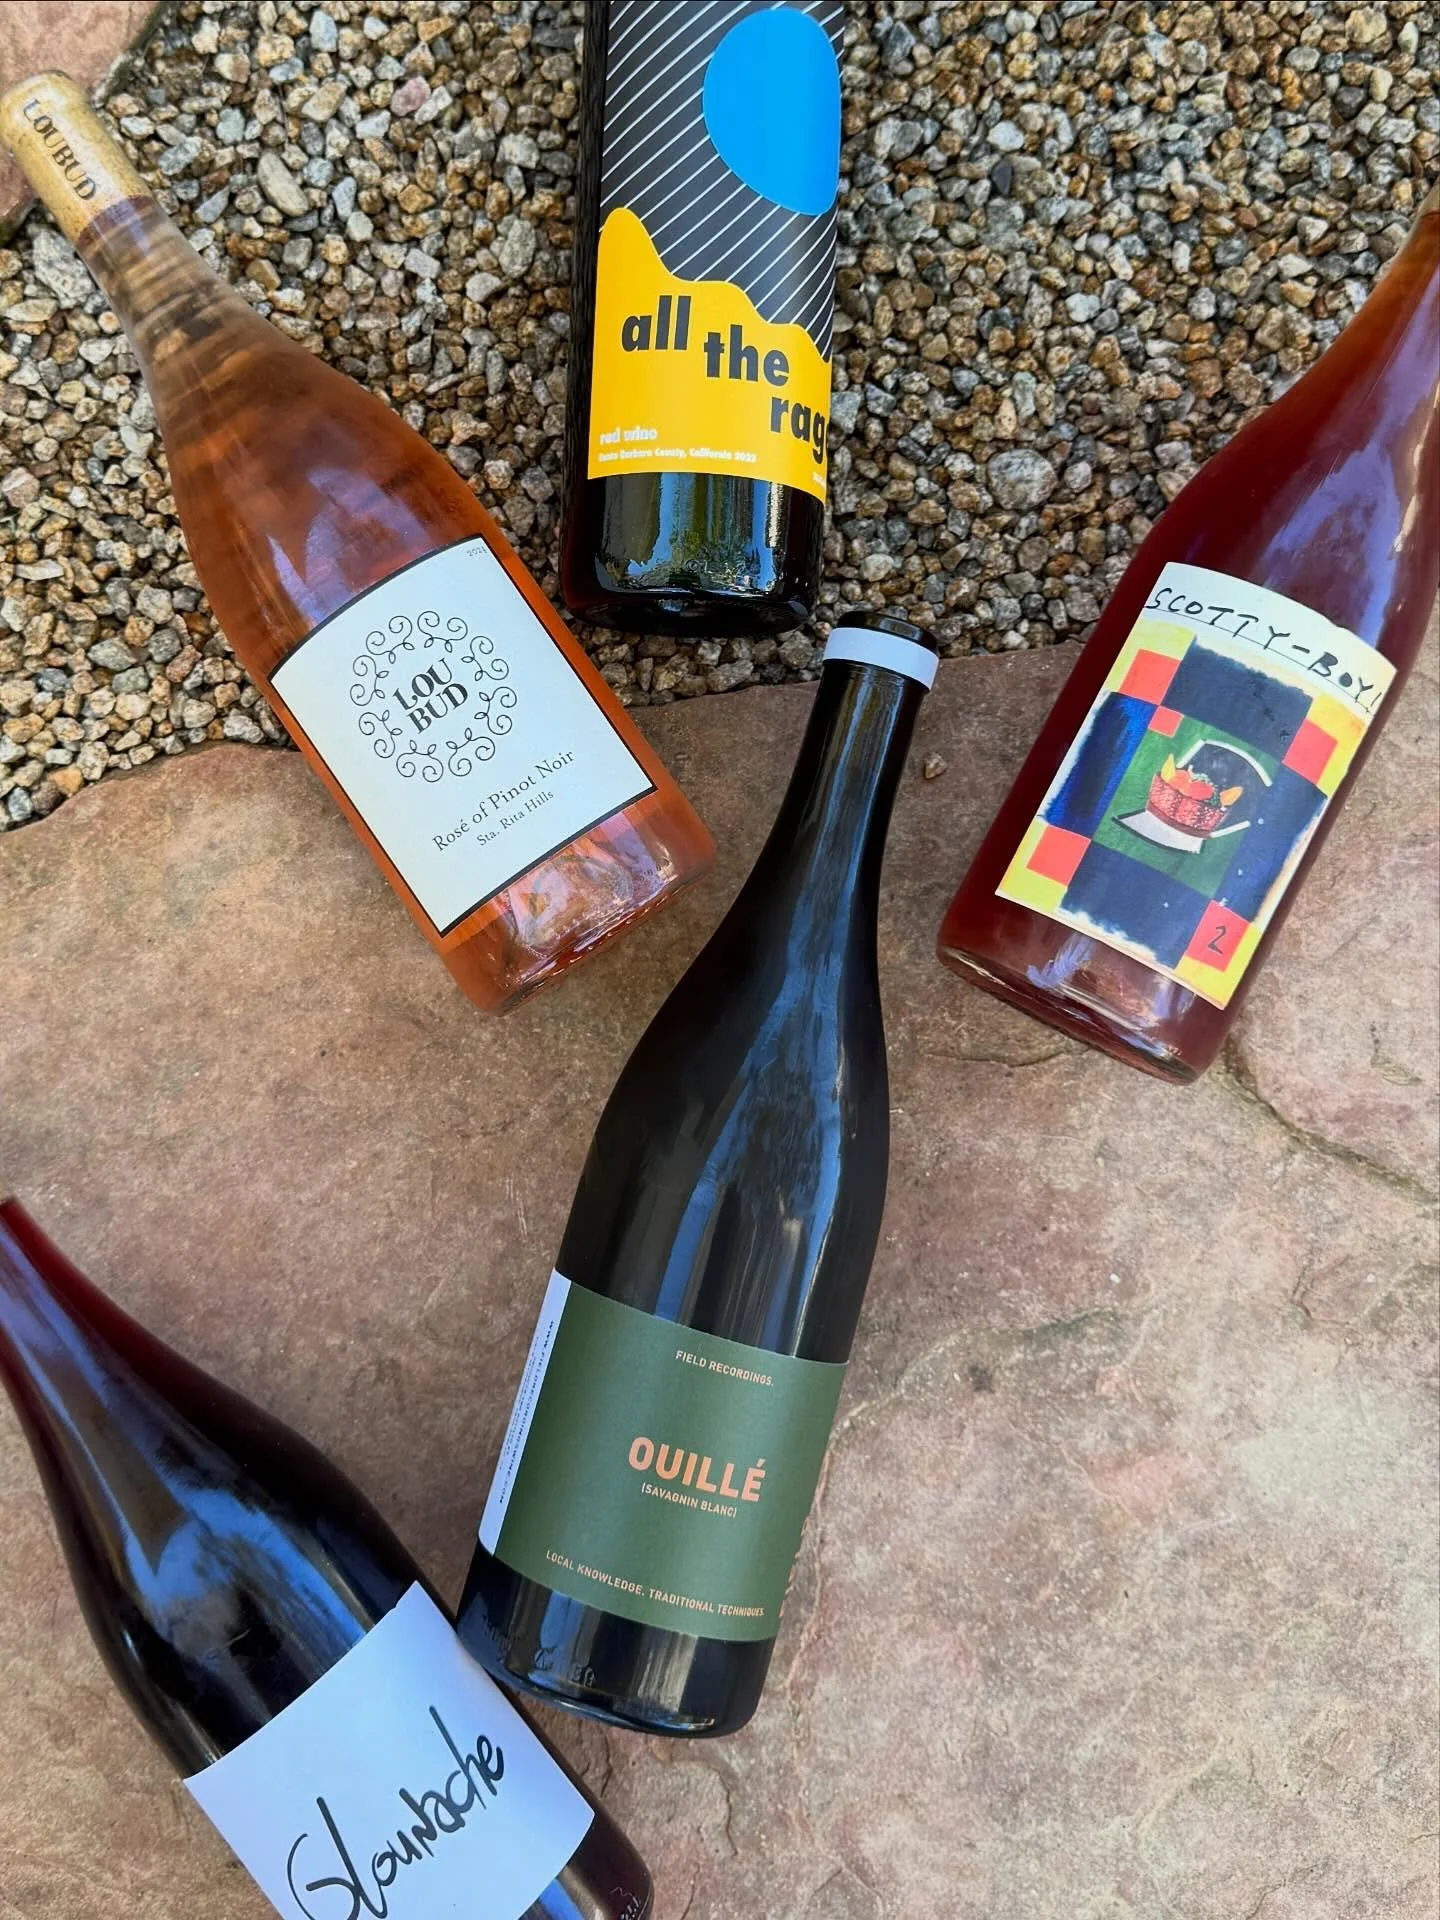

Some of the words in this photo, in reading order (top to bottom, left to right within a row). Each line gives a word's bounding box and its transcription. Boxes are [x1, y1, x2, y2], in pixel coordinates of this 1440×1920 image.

[621, 295, 692, 352] all
[704, 324, 790, 387] the
[689, 447, 733, 460] California
[770, 396, 829, 465] rag
[392, 658, 456, 711] LOU
[407, 682, 469, 735] BUD
[432, 819, 470, 851] Rosé
[472, 801, 489, 824] of
[488, 775, 537, 810] Pinot
[534, 751, 576, 779] Noir
[476, 830, 501, 846] Sta.
[500, 810, 526, 829] Rita
[524, 791, 554, 812] Hills
[1207, 925, 1228, 954] 2
[675, 1349, 707, 1368] FIELD
[709, 1360, 774, 1386] RECORDINGS.
[628, 1435, 767, 1502] OUILLÉ
[546, 1549, 575, 1571] LOCAL
[577, 1563, 645, 1597] KNOWLEDGE.
[649, 1588, 714, 1613] TRADITIONAL
[717, 1602, 765, 1617] TECHNIQUES.
